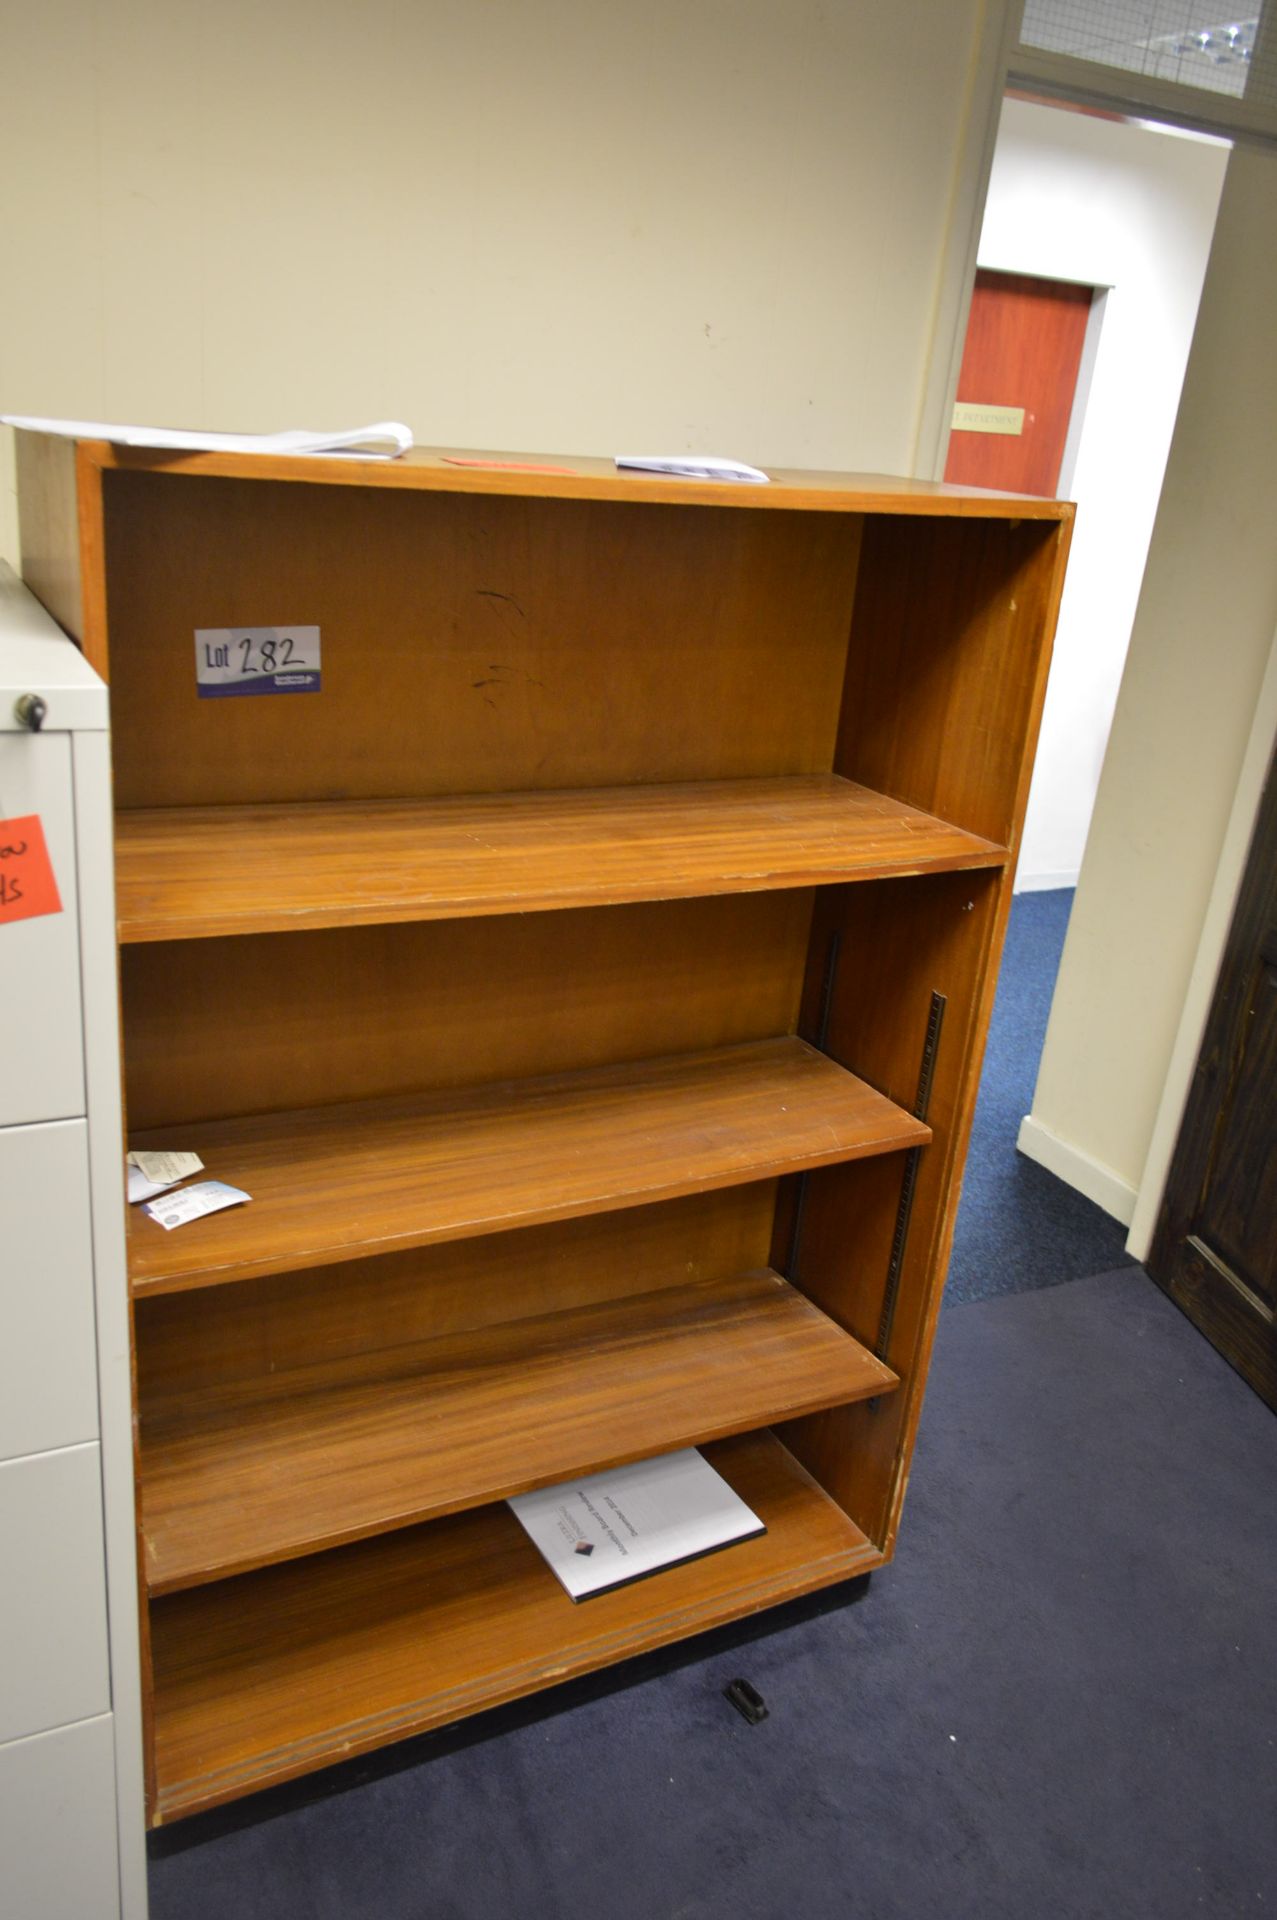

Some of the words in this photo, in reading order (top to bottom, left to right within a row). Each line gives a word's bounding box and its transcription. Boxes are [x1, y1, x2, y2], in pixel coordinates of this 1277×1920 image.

[205, 643, 230, 668] Lot
[239, 638, 306, 673] 282
[576, 1490, 595, 1512] Review
[591, 1511, 609, 1530] Board
[614, 1509, 639, 1537] December
[606, 1529, 629, 1556] Monthly
